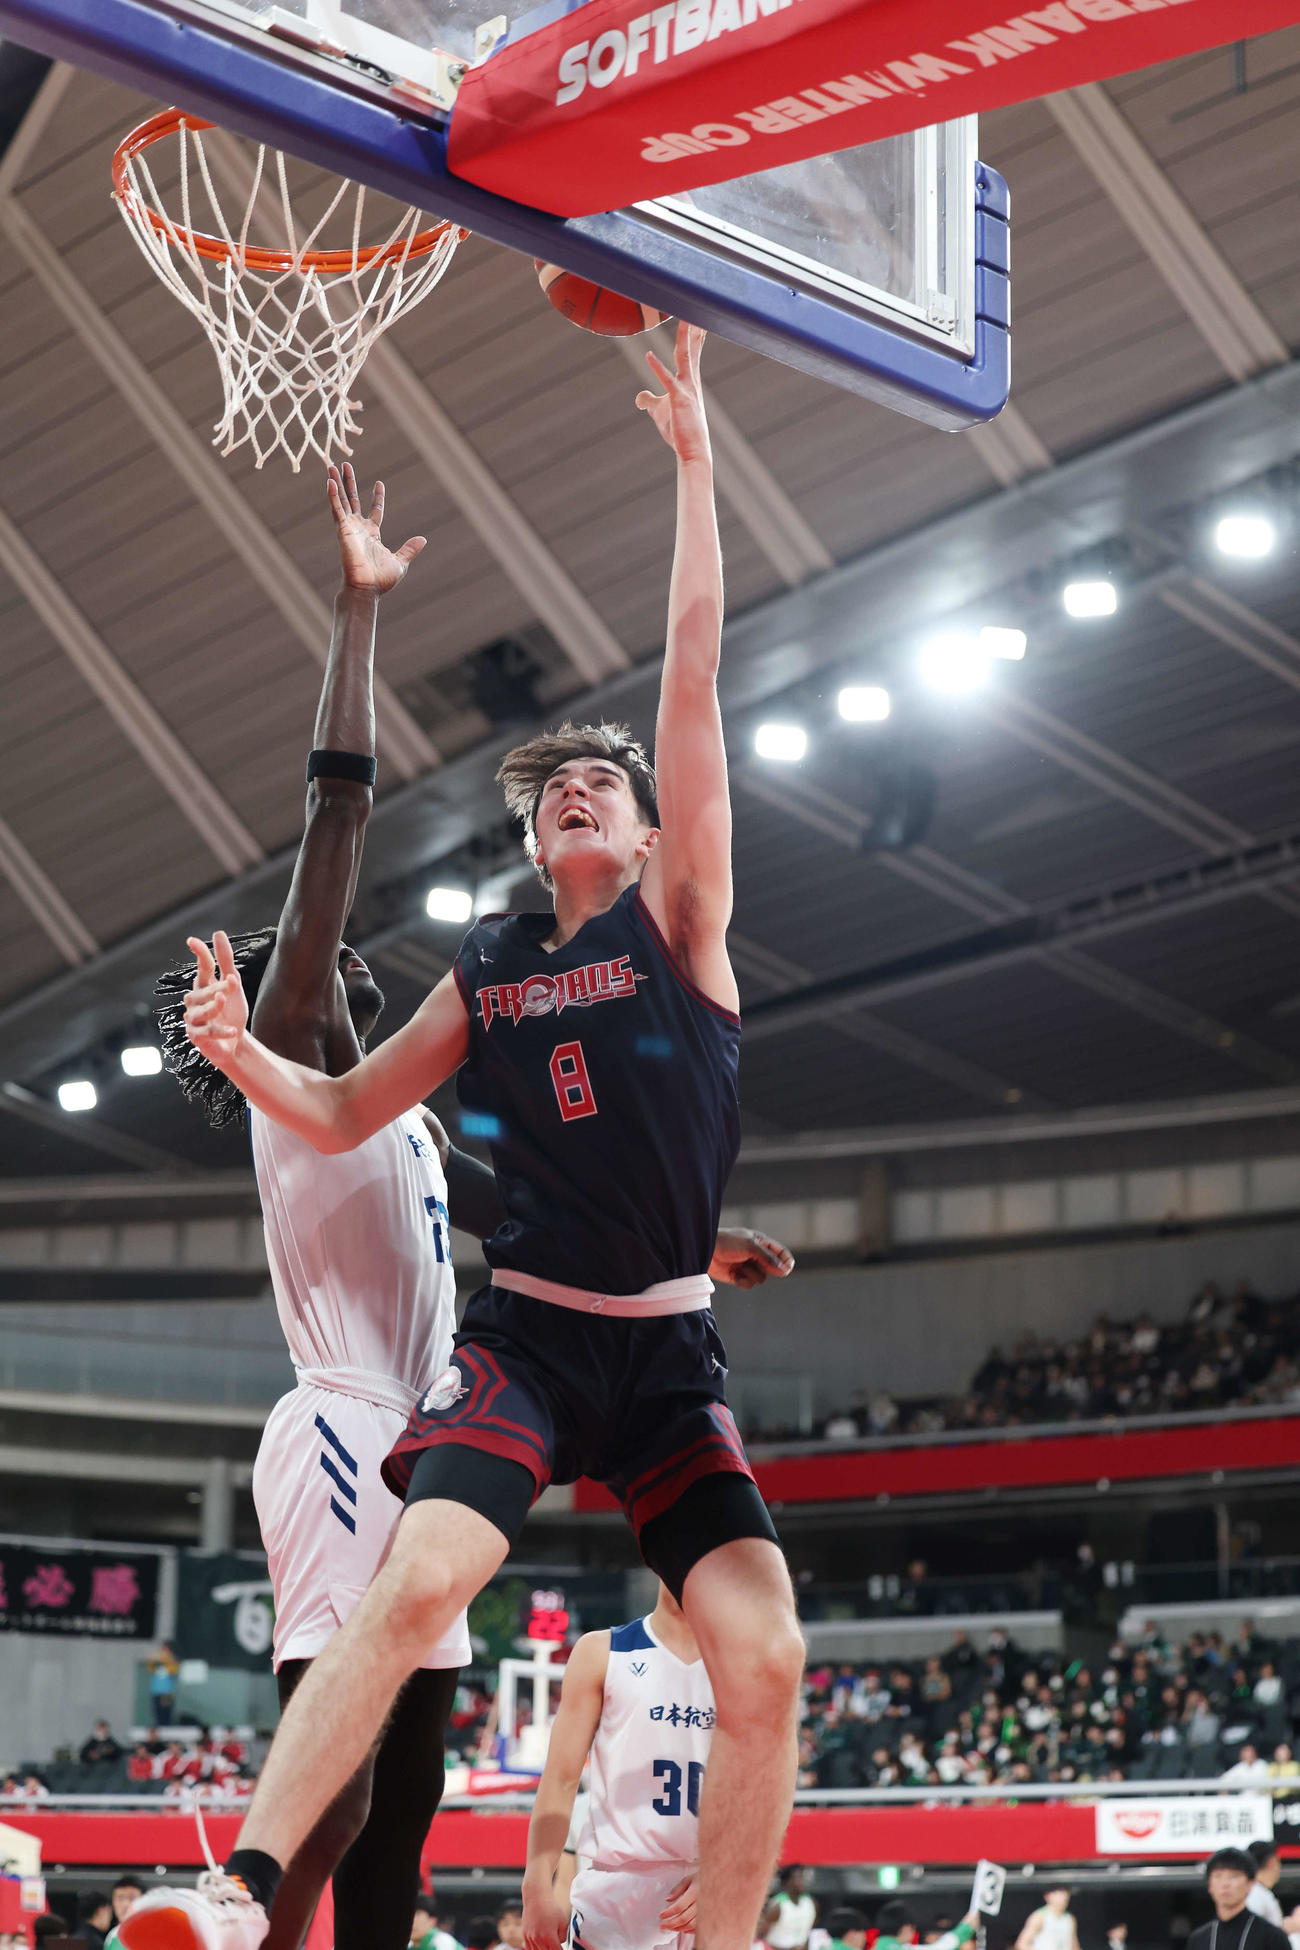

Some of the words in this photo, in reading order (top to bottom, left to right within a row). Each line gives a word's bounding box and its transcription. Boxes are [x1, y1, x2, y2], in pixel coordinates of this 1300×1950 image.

[556, 0, 803, 106] SOFTBA
[640, 123, 751, 163] CUP
[476, 954, 637, 1033] TROJANS
[549, 1039, 598, 1122] 8
